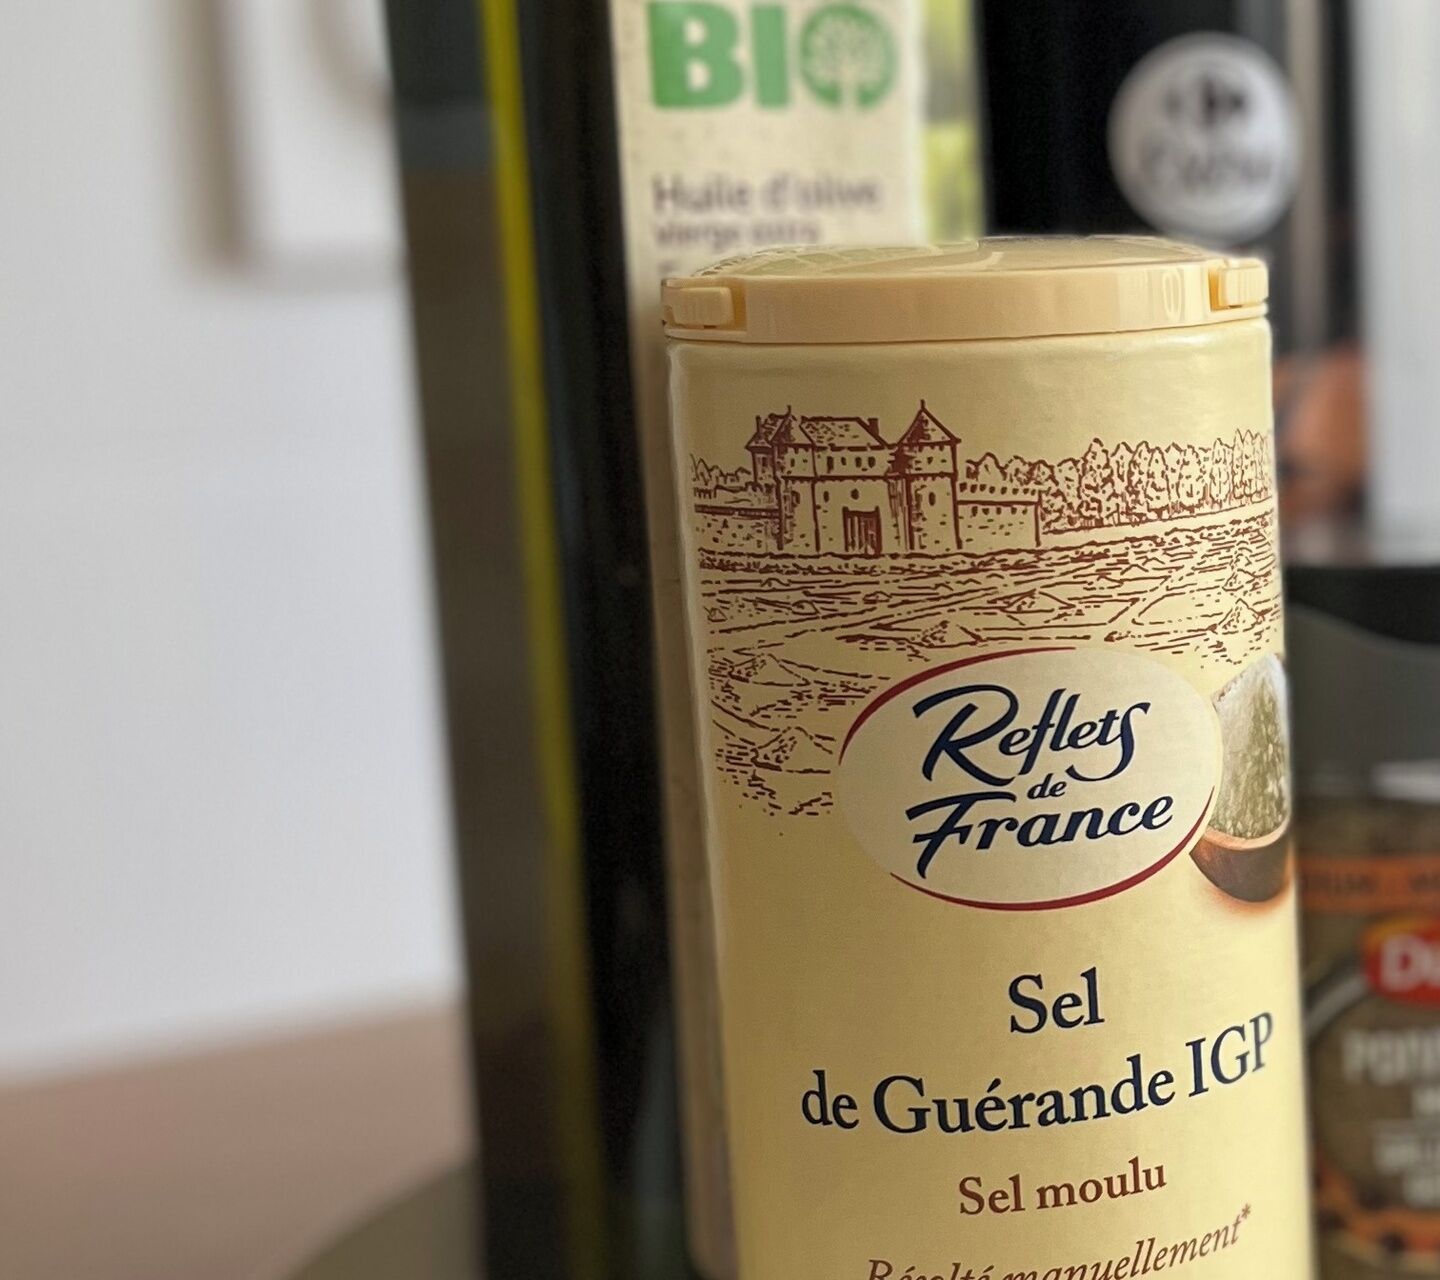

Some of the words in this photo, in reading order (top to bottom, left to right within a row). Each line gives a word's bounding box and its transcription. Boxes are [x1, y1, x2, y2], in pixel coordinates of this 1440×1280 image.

[647, 0, 898, 110] BIO
[653, 173, 748, 211] Huile
[912, 684, 1151, 786] Reflets
[1027, 773, 1067, 799] de
[905, 790, 1174, 879] France
[1007, 966, 1105, 1034] Sel
[801, 1069, 860, 1129] de
[873, 1053, 1176, 1134] Guérande
[1184, 1011, 1274, 1097] IGP
[959, 1174, 1026, 1215] Sel
[1036, 1156, 1167, 1210] moulu
